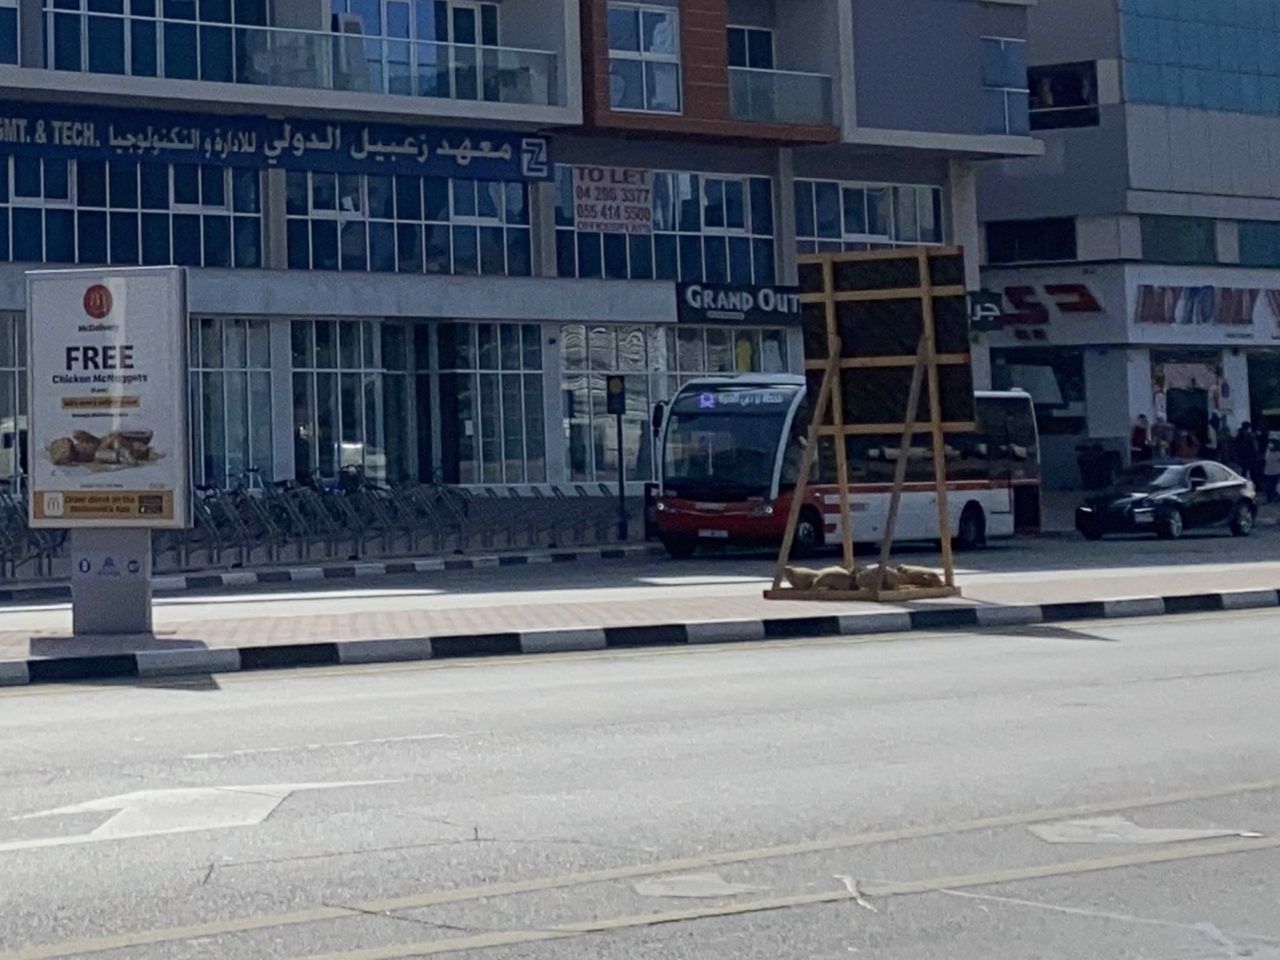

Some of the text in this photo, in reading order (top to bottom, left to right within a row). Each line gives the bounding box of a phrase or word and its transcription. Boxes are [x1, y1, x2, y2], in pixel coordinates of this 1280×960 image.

[34, 119, 47, 144] &
[51, 120, 100, 147] TECH.
[263, 121, 341, 164] الدولي
[350, 127, 429, 162] زعبيل
[436, 137, 512, 165] معهد
[575, 166, 649, 185] TO LET
[576, 185, 591, 200] 04
[621, 188, 650, 204] 3377
[577, 203, 597, 218] 055
[624, 206, 651, 222] 5500
[686, 285, 754, 312] GRAND
[65, 345, 135, 371] FREE
[52, 374, 92, 384] Chicken
